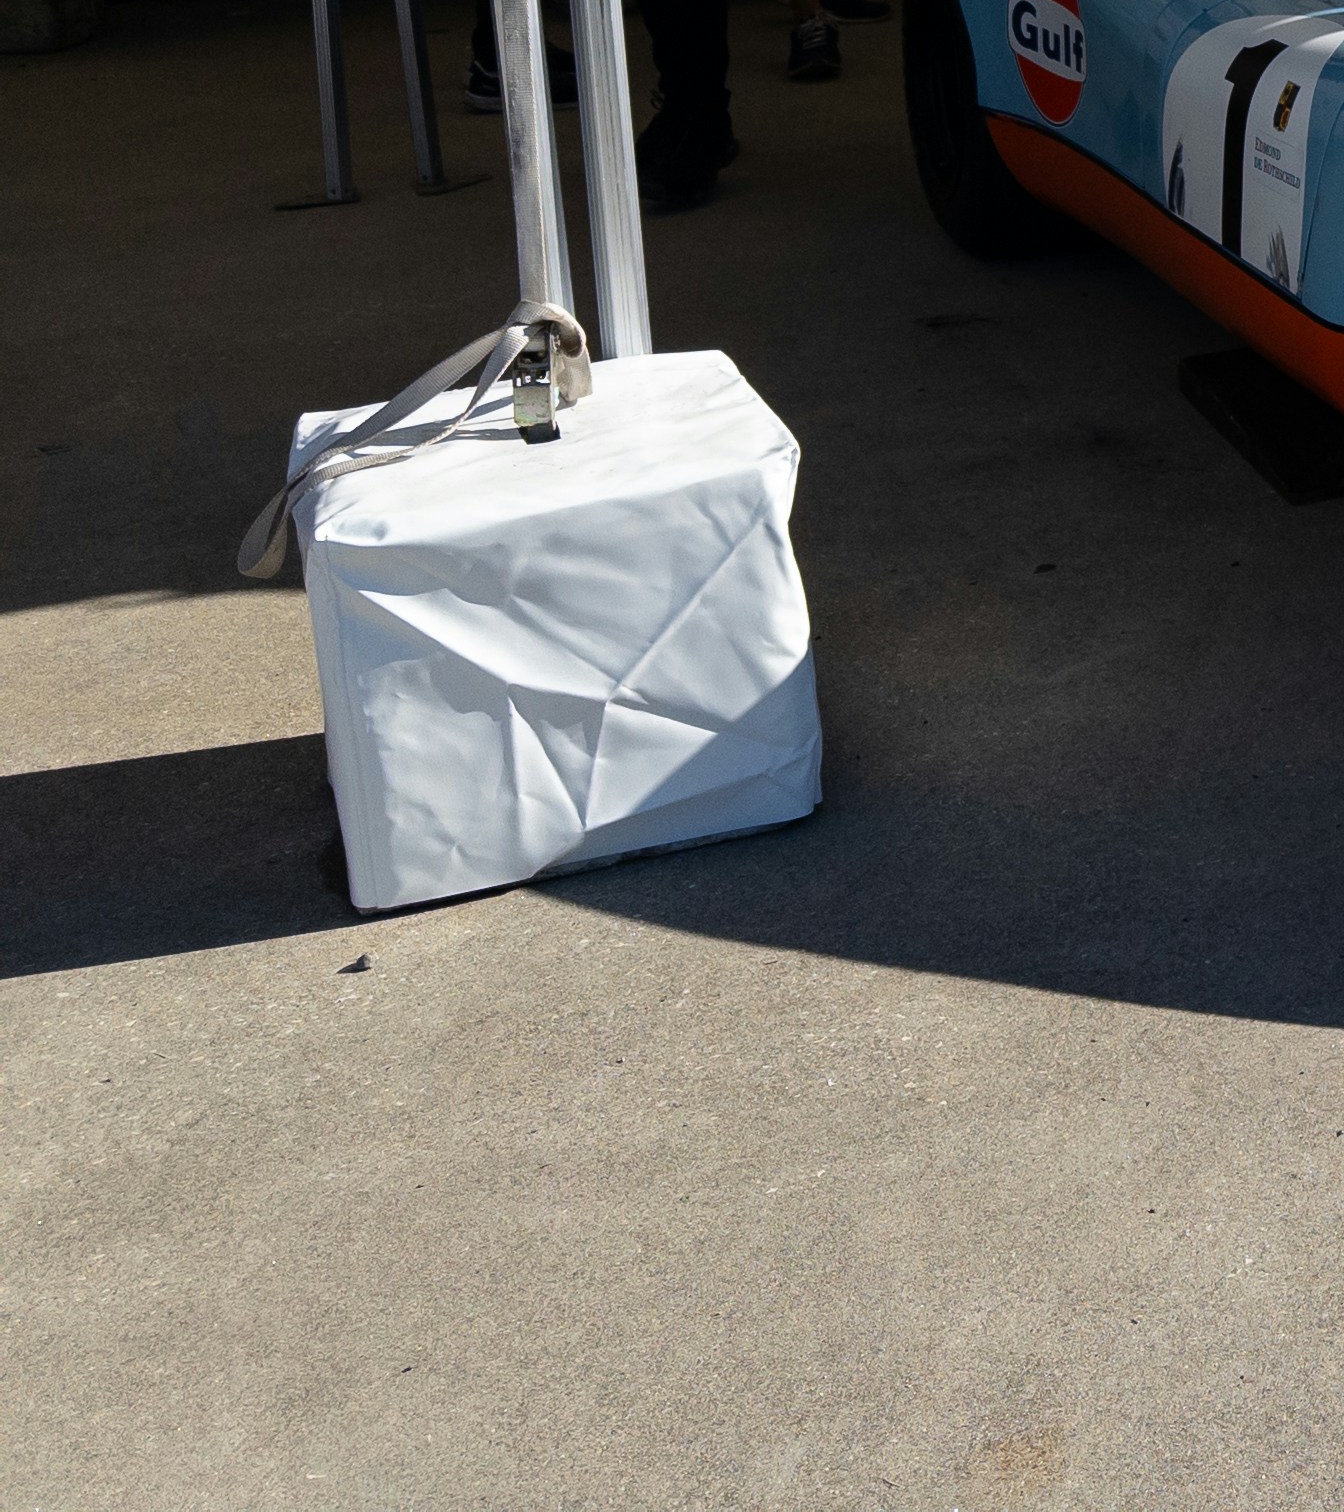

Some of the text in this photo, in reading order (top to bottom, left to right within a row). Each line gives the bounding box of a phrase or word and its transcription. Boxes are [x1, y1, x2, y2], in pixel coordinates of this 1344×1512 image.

[1012, 0, 1084, 74] Gulf
[1222, 39, 1290, 259] 1
[1254, 156, 1301, 189] DE ROTHSCHILD
[1255, 136, 1281, 160] EDMOND
